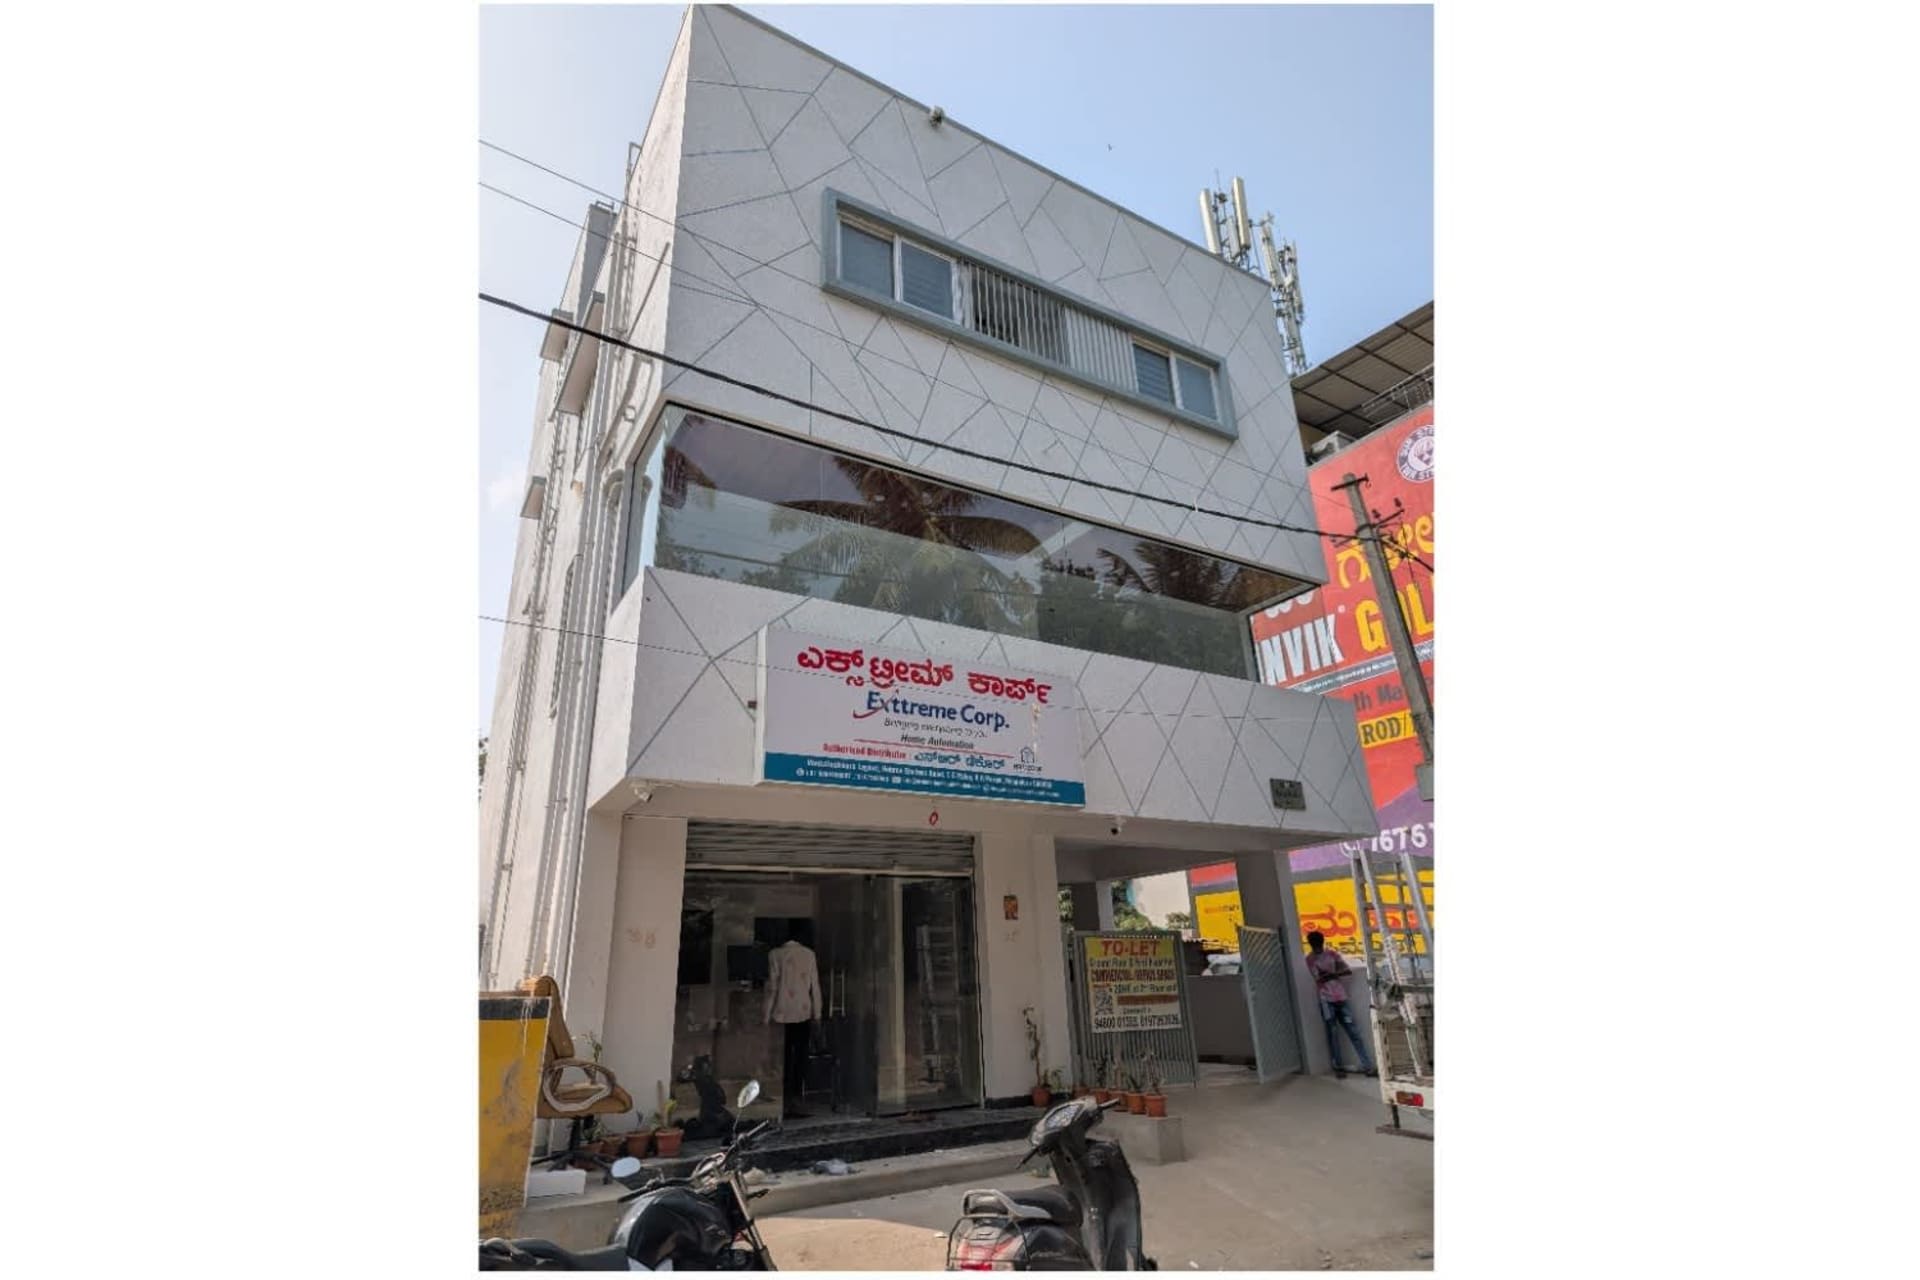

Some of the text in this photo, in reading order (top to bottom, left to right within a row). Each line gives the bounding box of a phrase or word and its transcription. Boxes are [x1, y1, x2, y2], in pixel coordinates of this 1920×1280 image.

[1253, 614, 1344, 686] NVIK
[865, 688, 1009, 732] Exttreme Corp.
[901, 733, 974, 749] Home Automation
